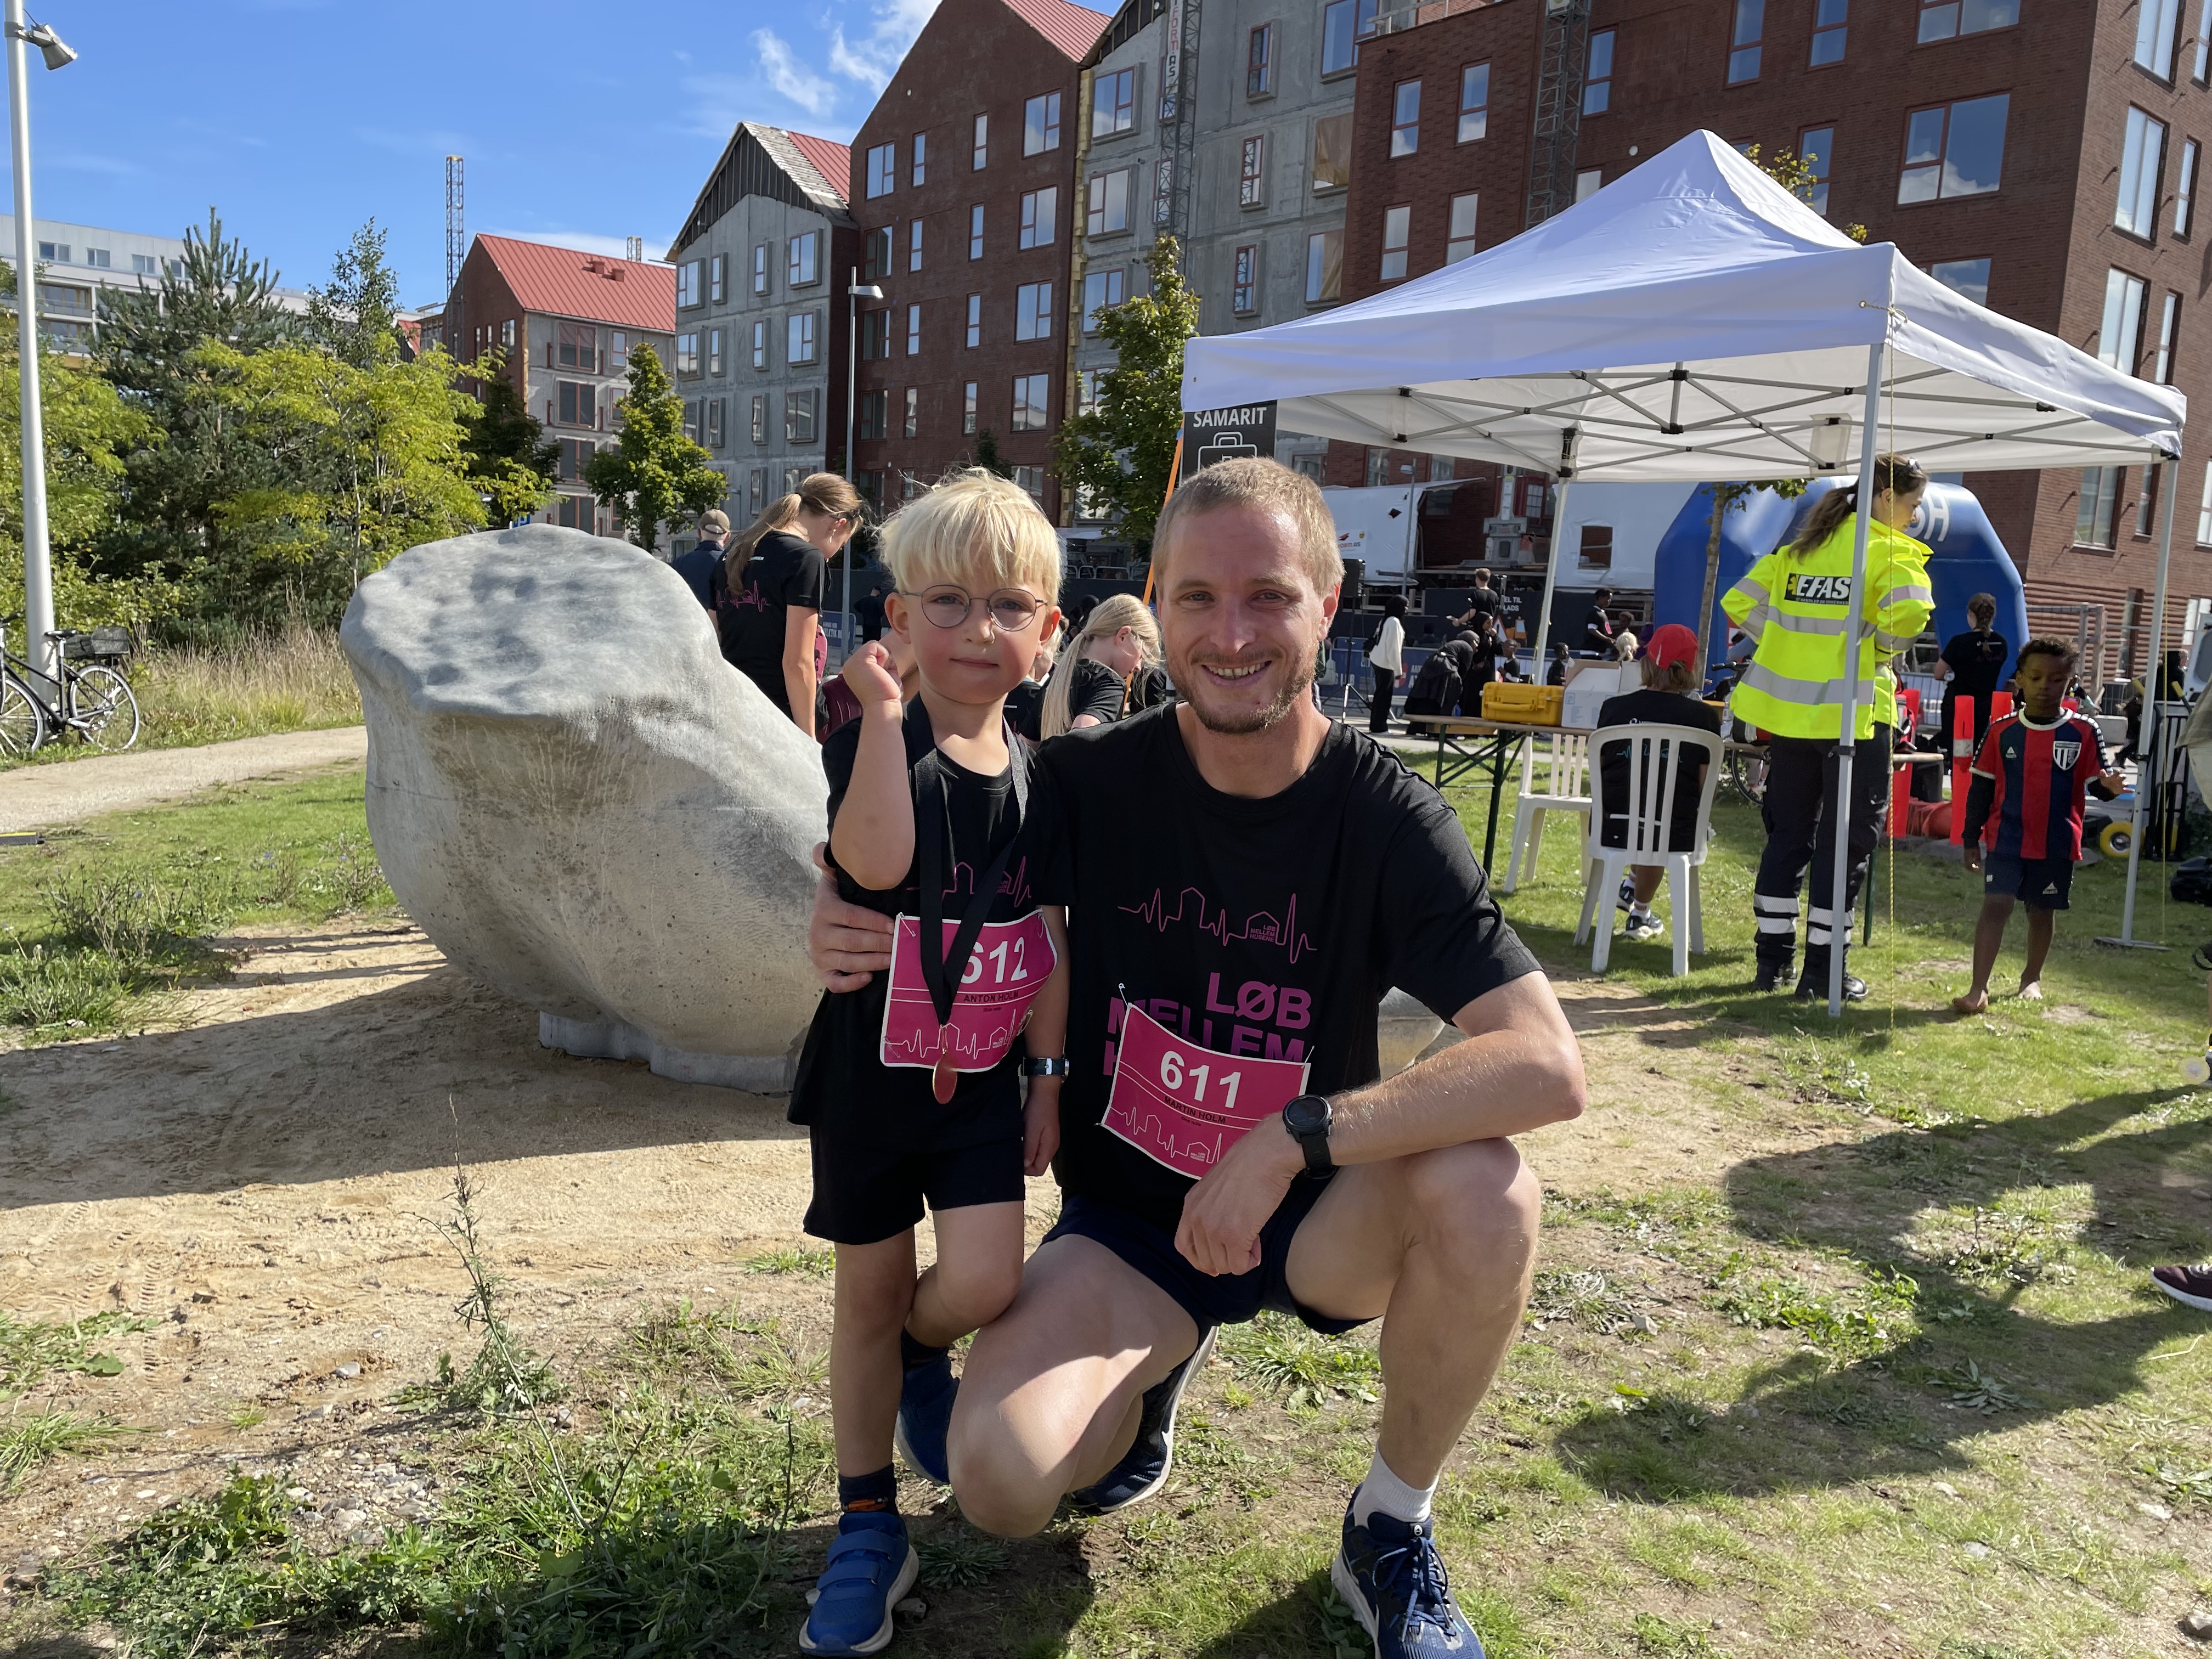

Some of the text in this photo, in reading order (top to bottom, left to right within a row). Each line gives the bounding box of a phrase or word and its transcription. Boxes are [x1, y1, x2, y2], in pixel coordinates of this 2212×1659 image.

[1193, 407, 1267, 427] SAMARIT
[1797, 575, 1851, 599] EFAS
[1249, 934, 1274, 943] HUSENE
[1250, 928, 1275, 937] MELLEM
[961, 936, 1028, 984] 612
[1206, 972, 1311, 1029] LØB
[1160, 1051, 1241, 1108] 611
[1164, 1096, 1226, 1124] MARTIN HOLM
